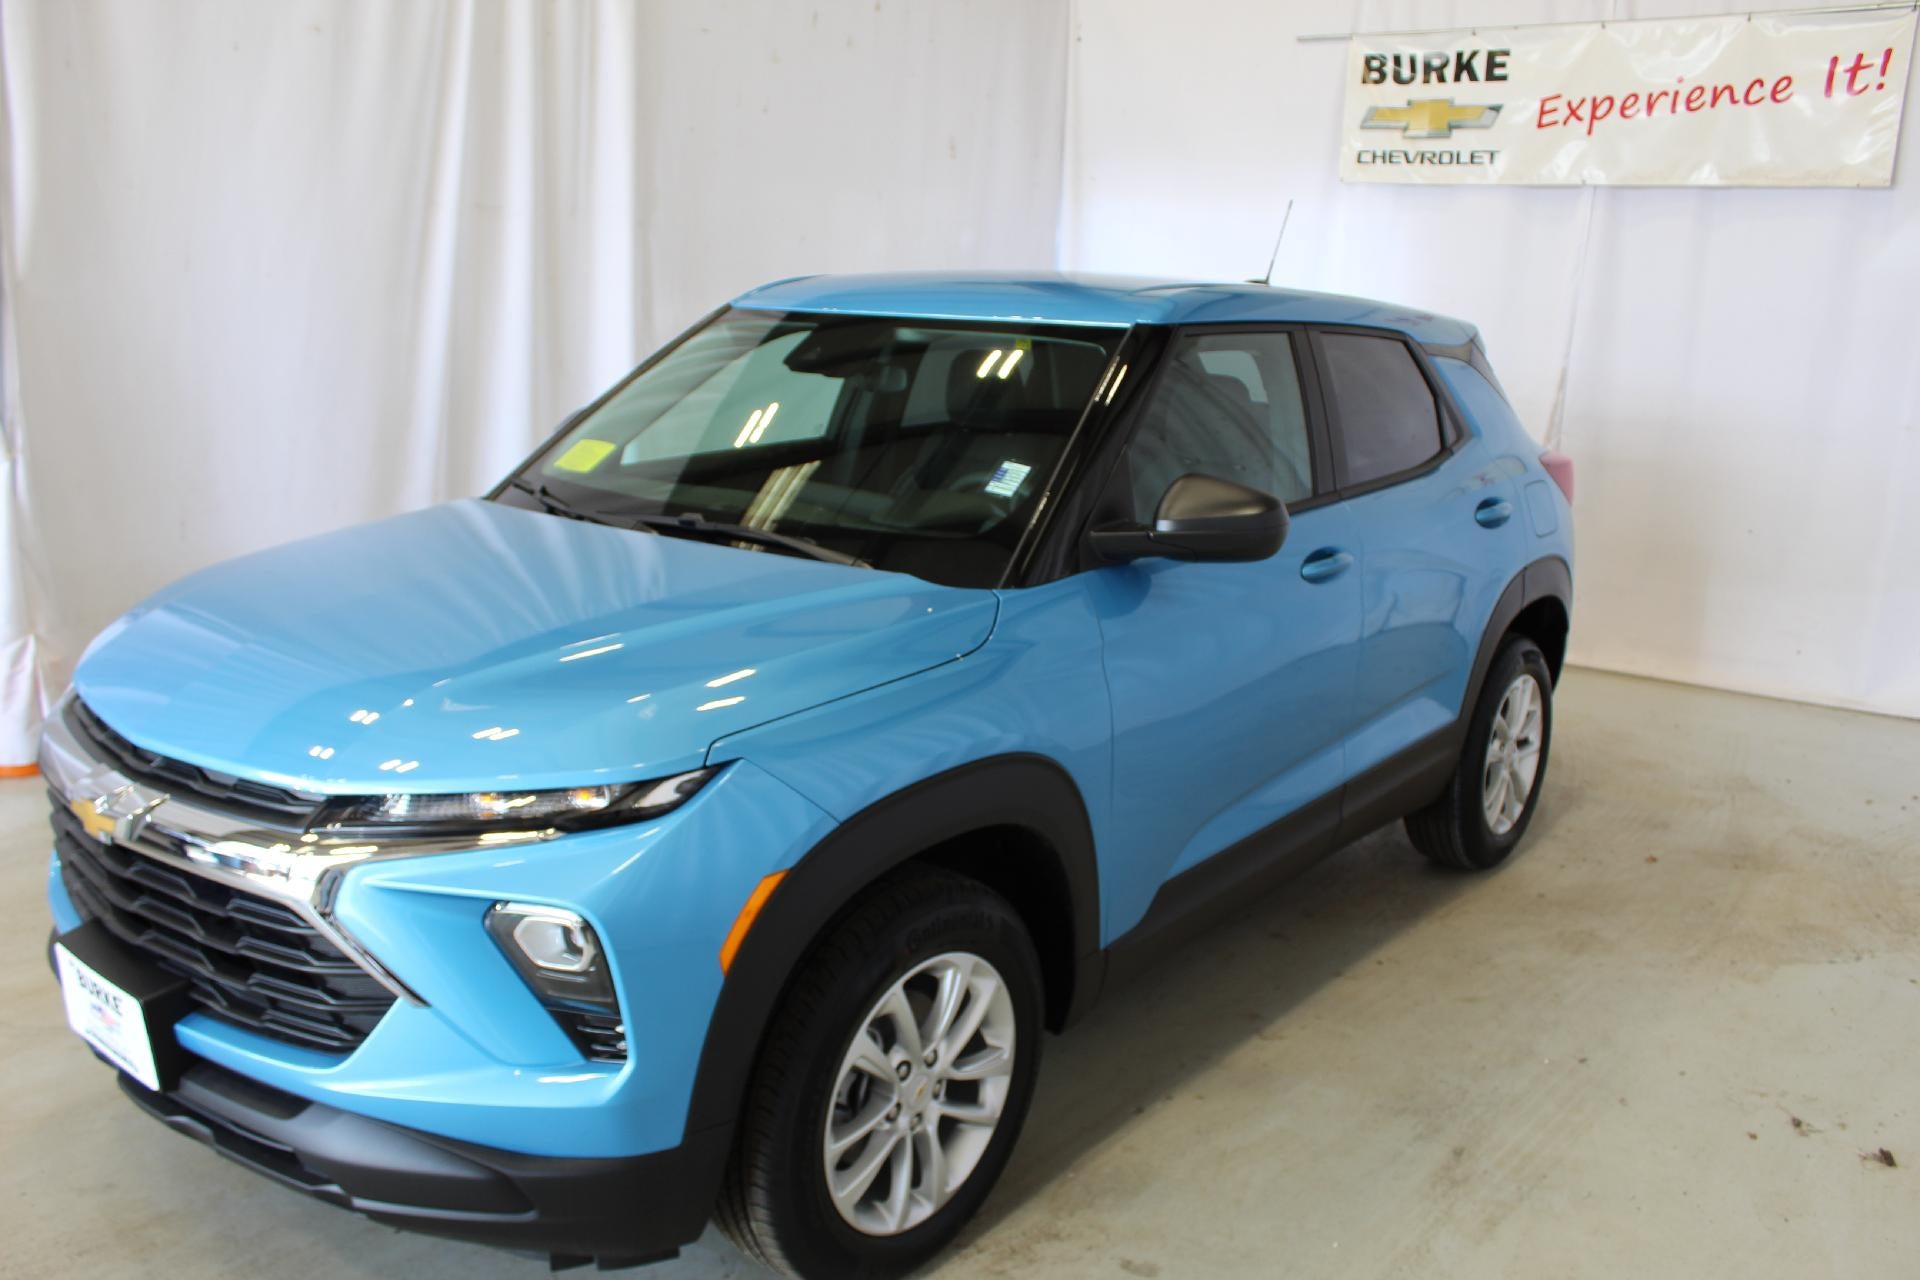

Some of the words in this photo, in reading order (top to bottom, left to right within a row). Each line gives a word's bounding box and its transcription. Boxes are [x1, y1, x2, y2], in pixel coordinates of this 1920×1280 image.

[1361, 48, 1510, 85] BURKE
[1536, 75, 1793, 136] Experience
[1824, 47, 1893, 98] It!
[1357, 149, 1499, 165] CHEVROLET
